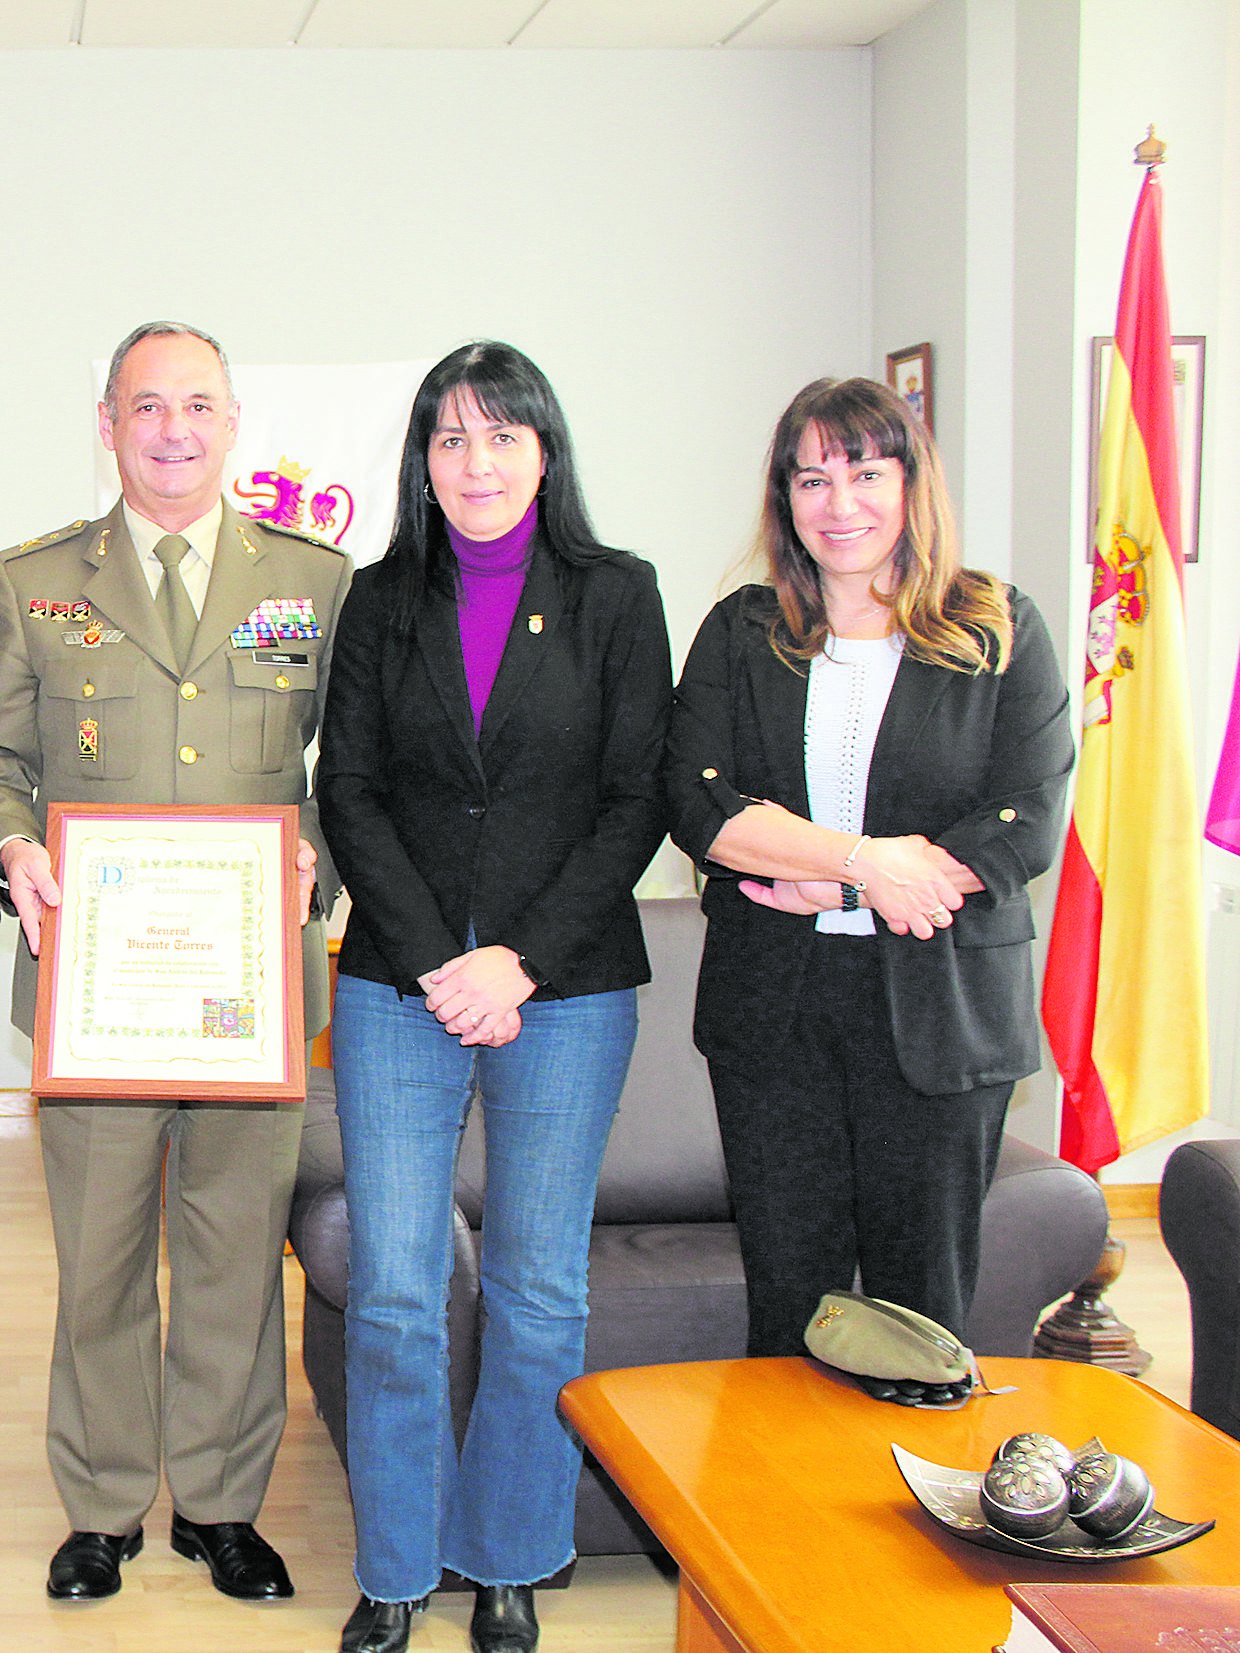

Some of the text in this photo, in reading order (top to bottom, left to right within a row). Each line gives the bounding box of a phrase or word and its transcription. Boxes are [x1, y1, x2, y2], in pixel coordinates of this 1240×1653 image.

[147, 926, 190, 936] General
[127, 938, 213, 950] Vicente Torres
